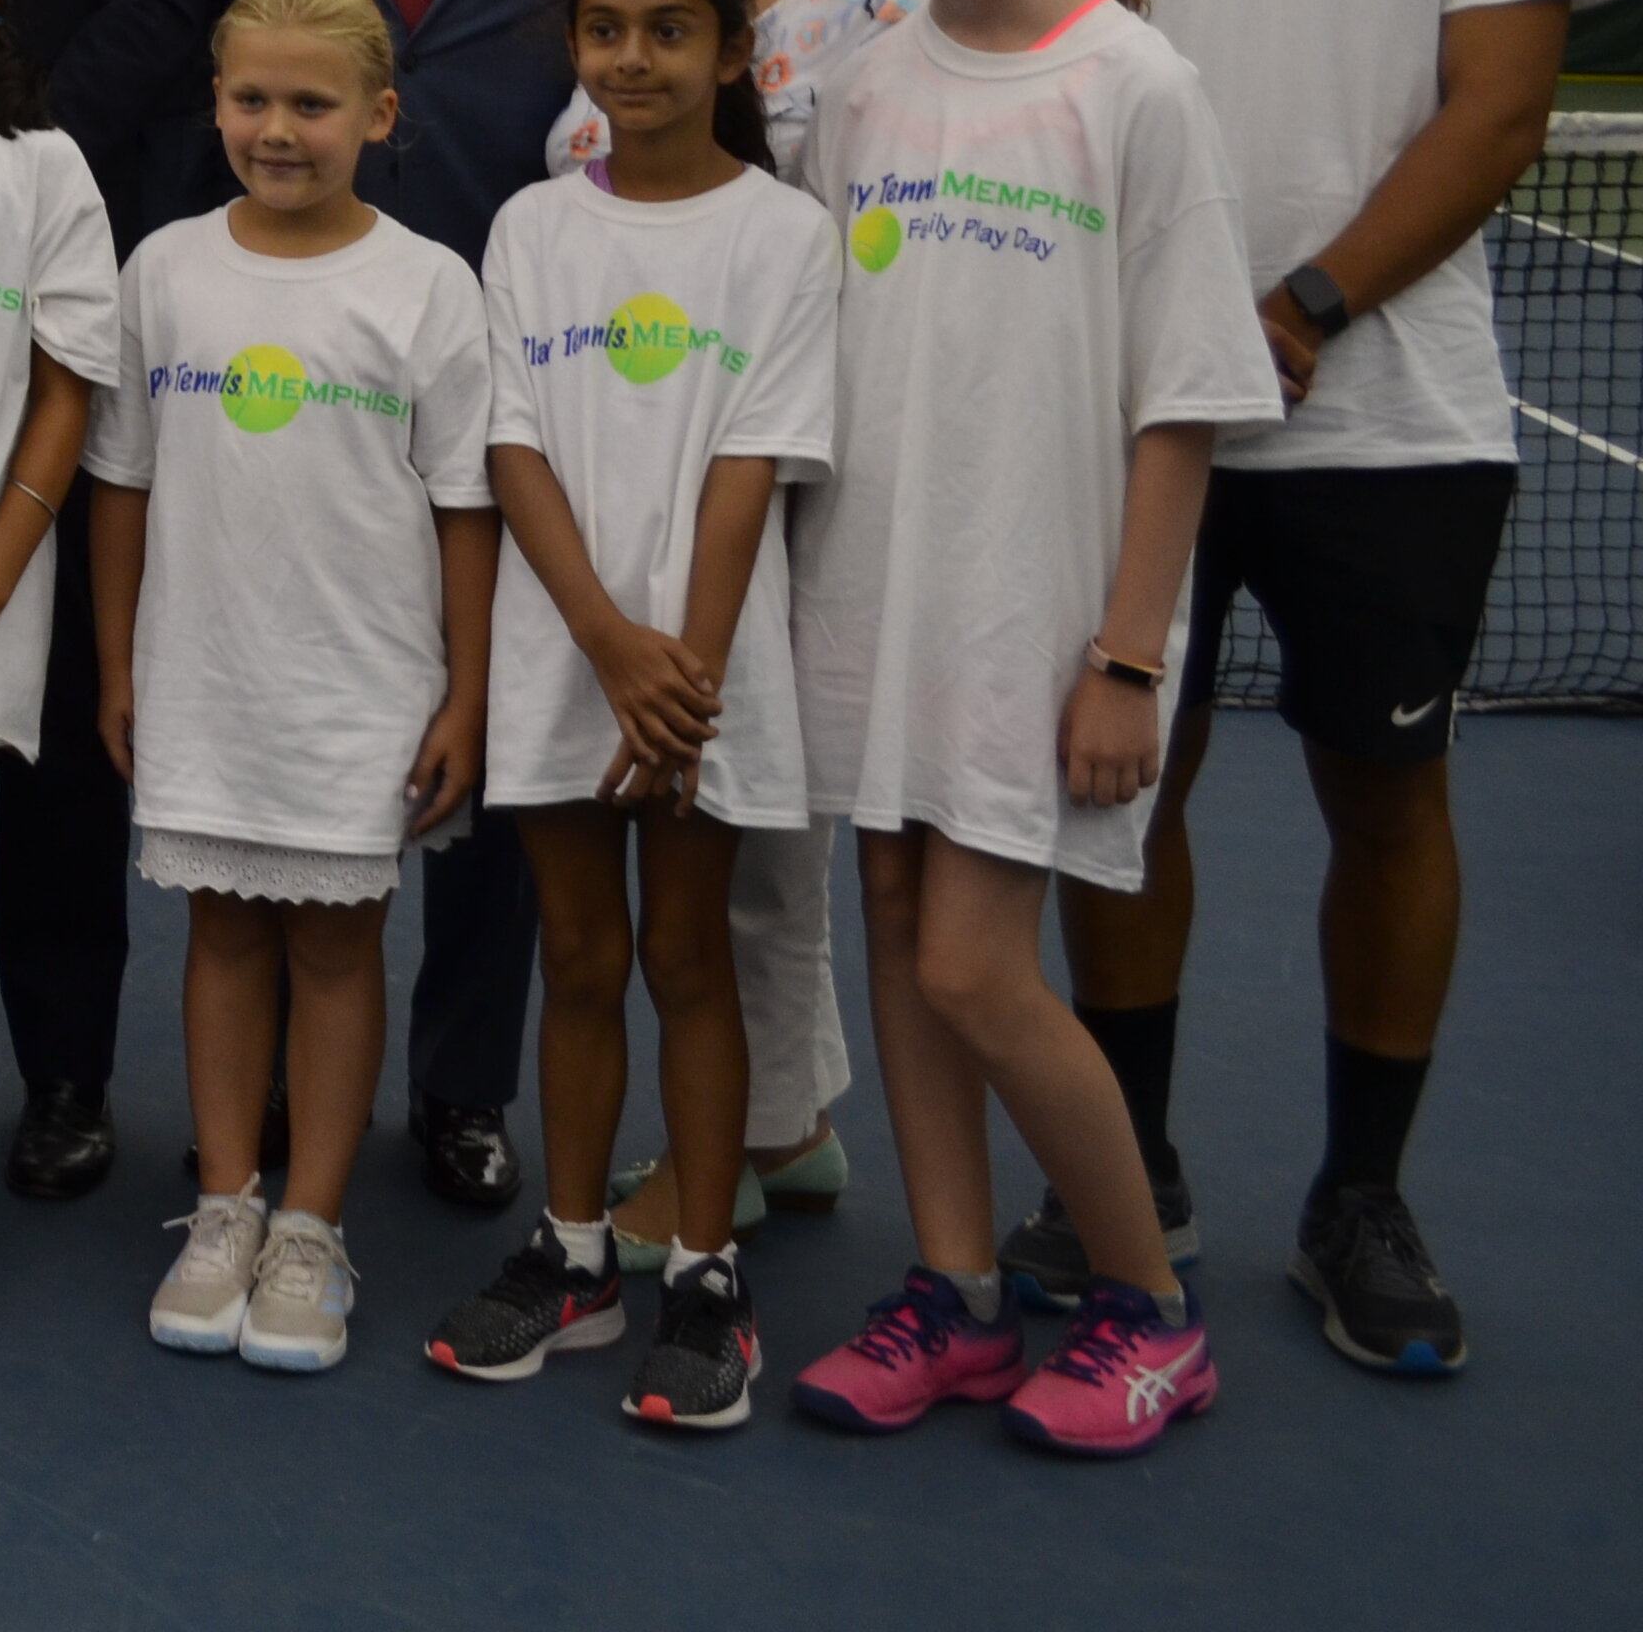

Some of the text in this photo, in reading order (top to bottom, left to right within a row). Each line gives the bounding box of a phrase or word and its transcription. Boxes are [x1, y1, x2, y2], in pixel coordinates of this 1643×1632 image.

[962, 218, 1009, 252] Play
[1012, 225, 1057, 262] Day
[246, 369, 411, 424] MEMPHIS!
